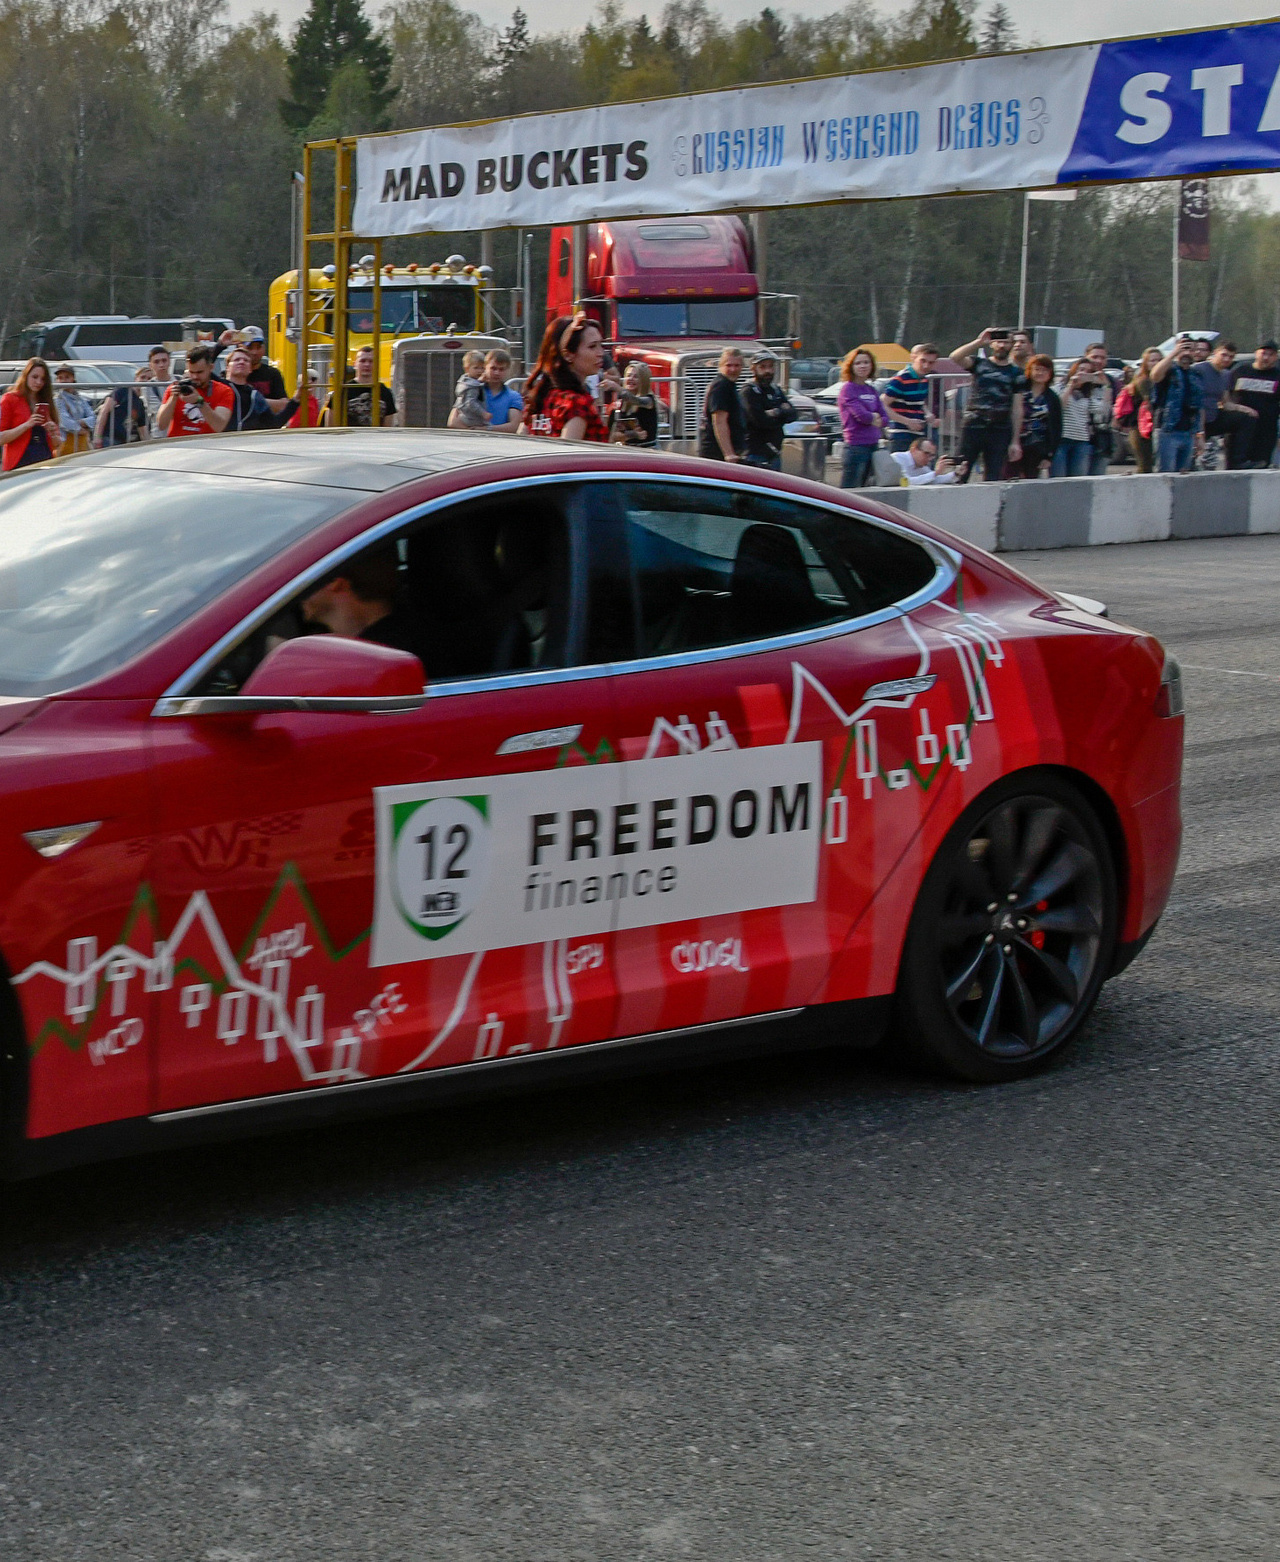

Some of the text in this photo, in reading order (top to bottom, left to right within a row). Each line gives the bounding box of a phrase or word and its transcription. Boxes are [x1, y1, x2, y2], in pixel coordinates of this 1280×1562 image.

[380, 140, 648, 203] MAD BUCKETS
[414, 823, 472, 882] 12
[527, 782, 812, 867] FREEDOM
[523, 865, 678, 912] finance
